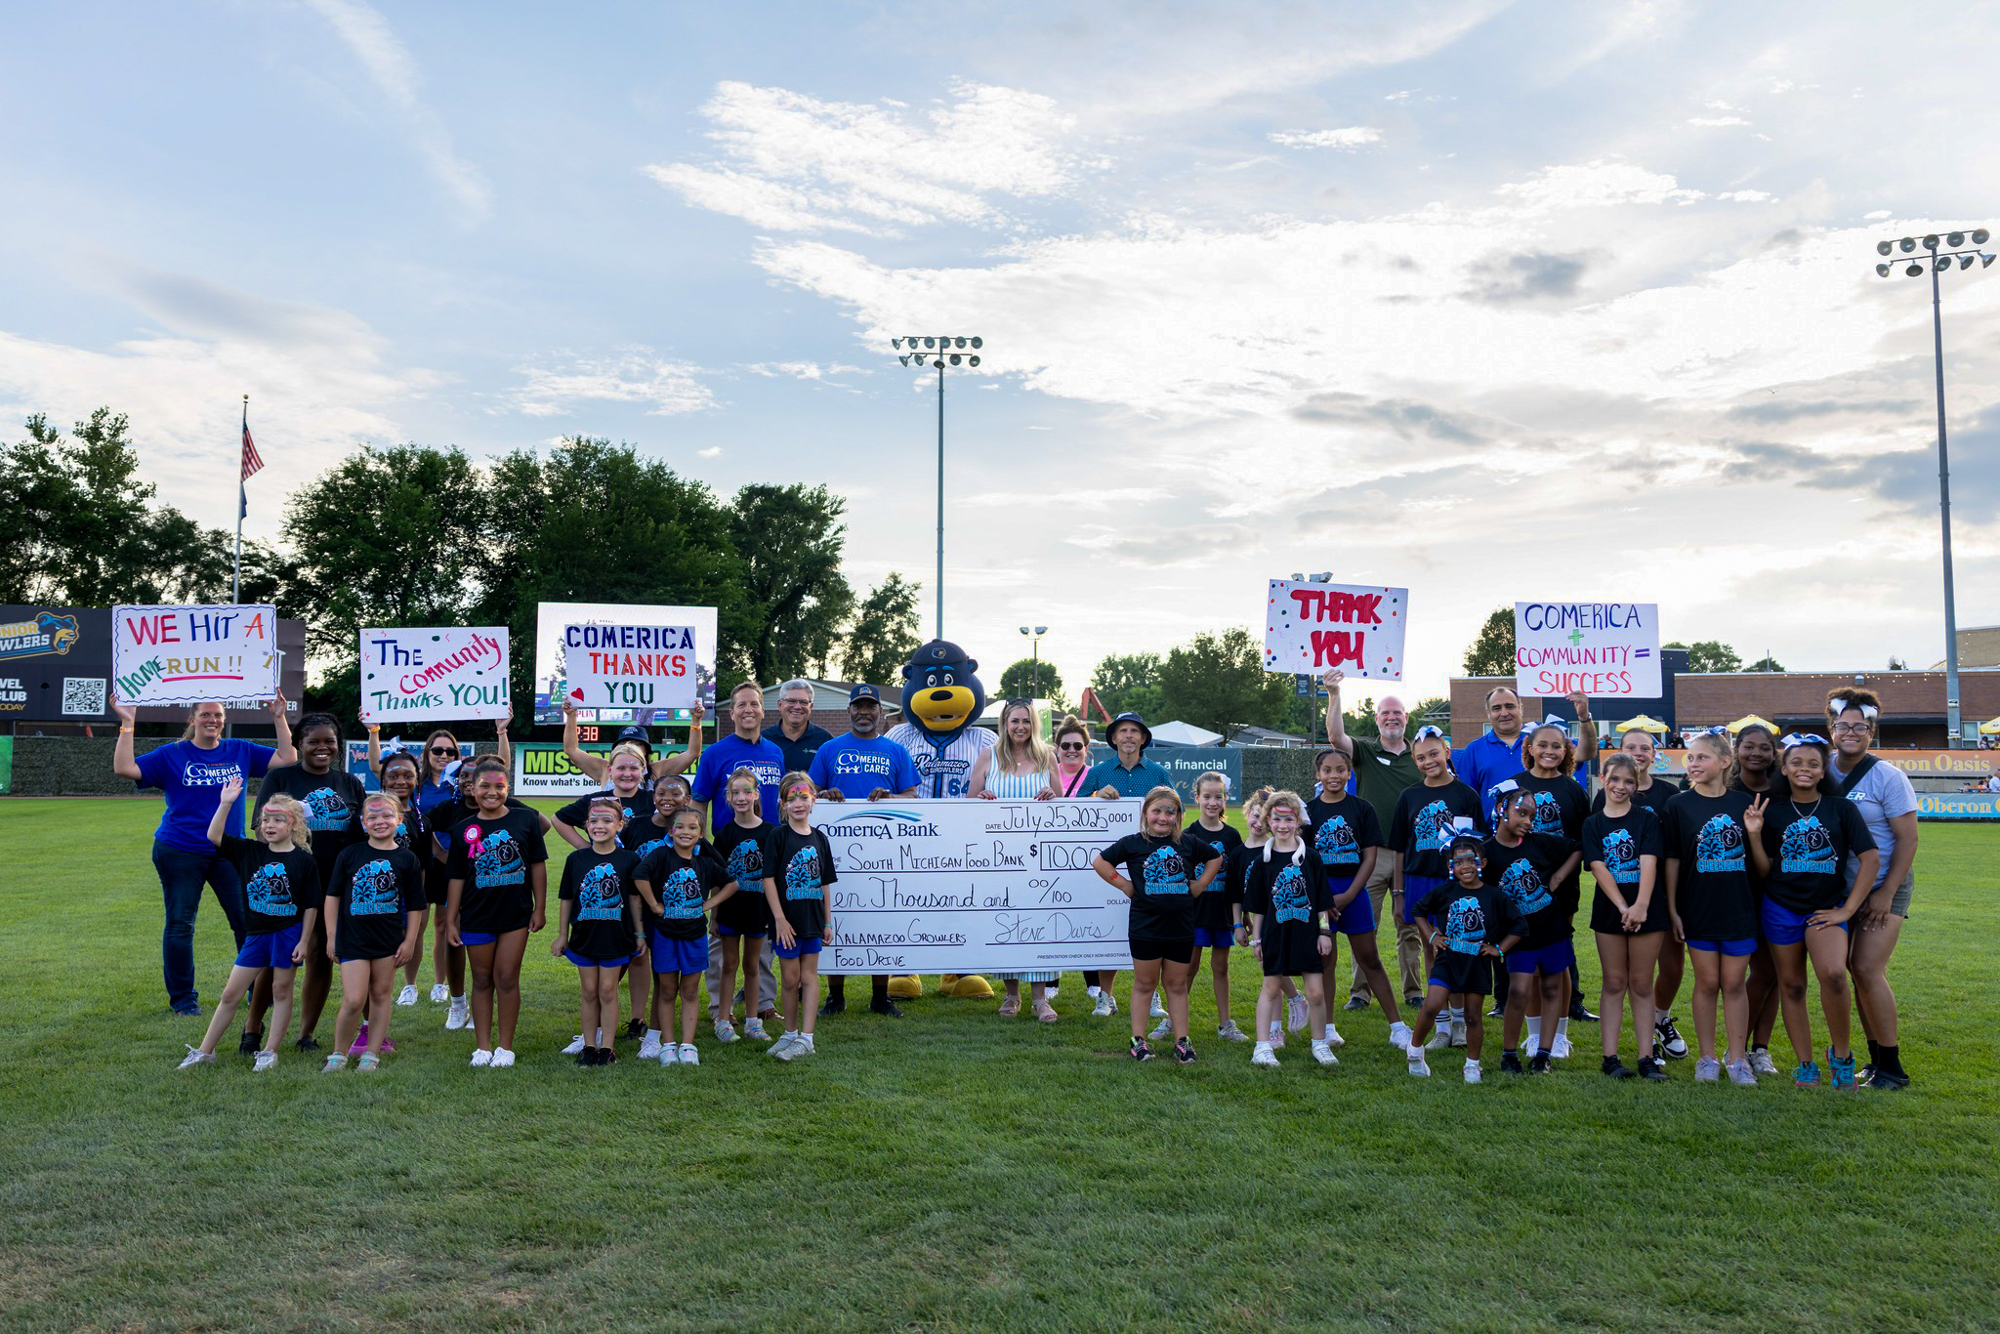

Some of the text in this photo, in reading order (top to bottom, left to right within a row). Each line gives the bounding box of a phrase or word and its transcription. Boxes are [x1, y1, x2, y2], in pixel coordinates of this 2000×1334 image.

[1290, 589, 1382, 624] THANK
[1524, 603, 1642, 631] COMERICA
[0, 622, 39, 637] NIOR
[126, 614, 180, 645] WE
[244, 613, 264, 639] A
[566, 626, 694, 650] COMERICA
[0, 634, 50, 652] WLERS
[1310, 630, 1364, 670] YOU
[589, 652, 686, 677] THANKS
[116, 655, 167, 699] HOME
[1533, 670, 1632, 694] SUCCESS
[448, 677, 508, 707] YOU!
[604, 682, 654, 704] YOU
[0, 703, 26, 711] ODAY
[864, 763, 890, 775] CARES
[1175, 759, 1227, 770] financial
[1935, 754, 1991, 773] Oasis
[523, 778, 548, 786] Know
[551, 778, 580, 786] what's
[1917, 796, 1991, 814] Oberon
[897, 823, 939, 837] Bank
[1000, 806, 1042, 838] July
[1109, 813, 1133, 823] 0001
[848, 840, 1025, 871] SOUTH MICHIGAN FOOD BANK
[1030, 844, 1038, 858] $
[833, 892, 866, 908] en
[868, 876, 978, 909] Thousand
[983, 887, 1017, 909] and
[834, 916, 967, 946] KALAMAZOO GROWLERS
[995, 912, 1048, 944] Steve
[834, 948, 906, 968] FOOD DRIVE
